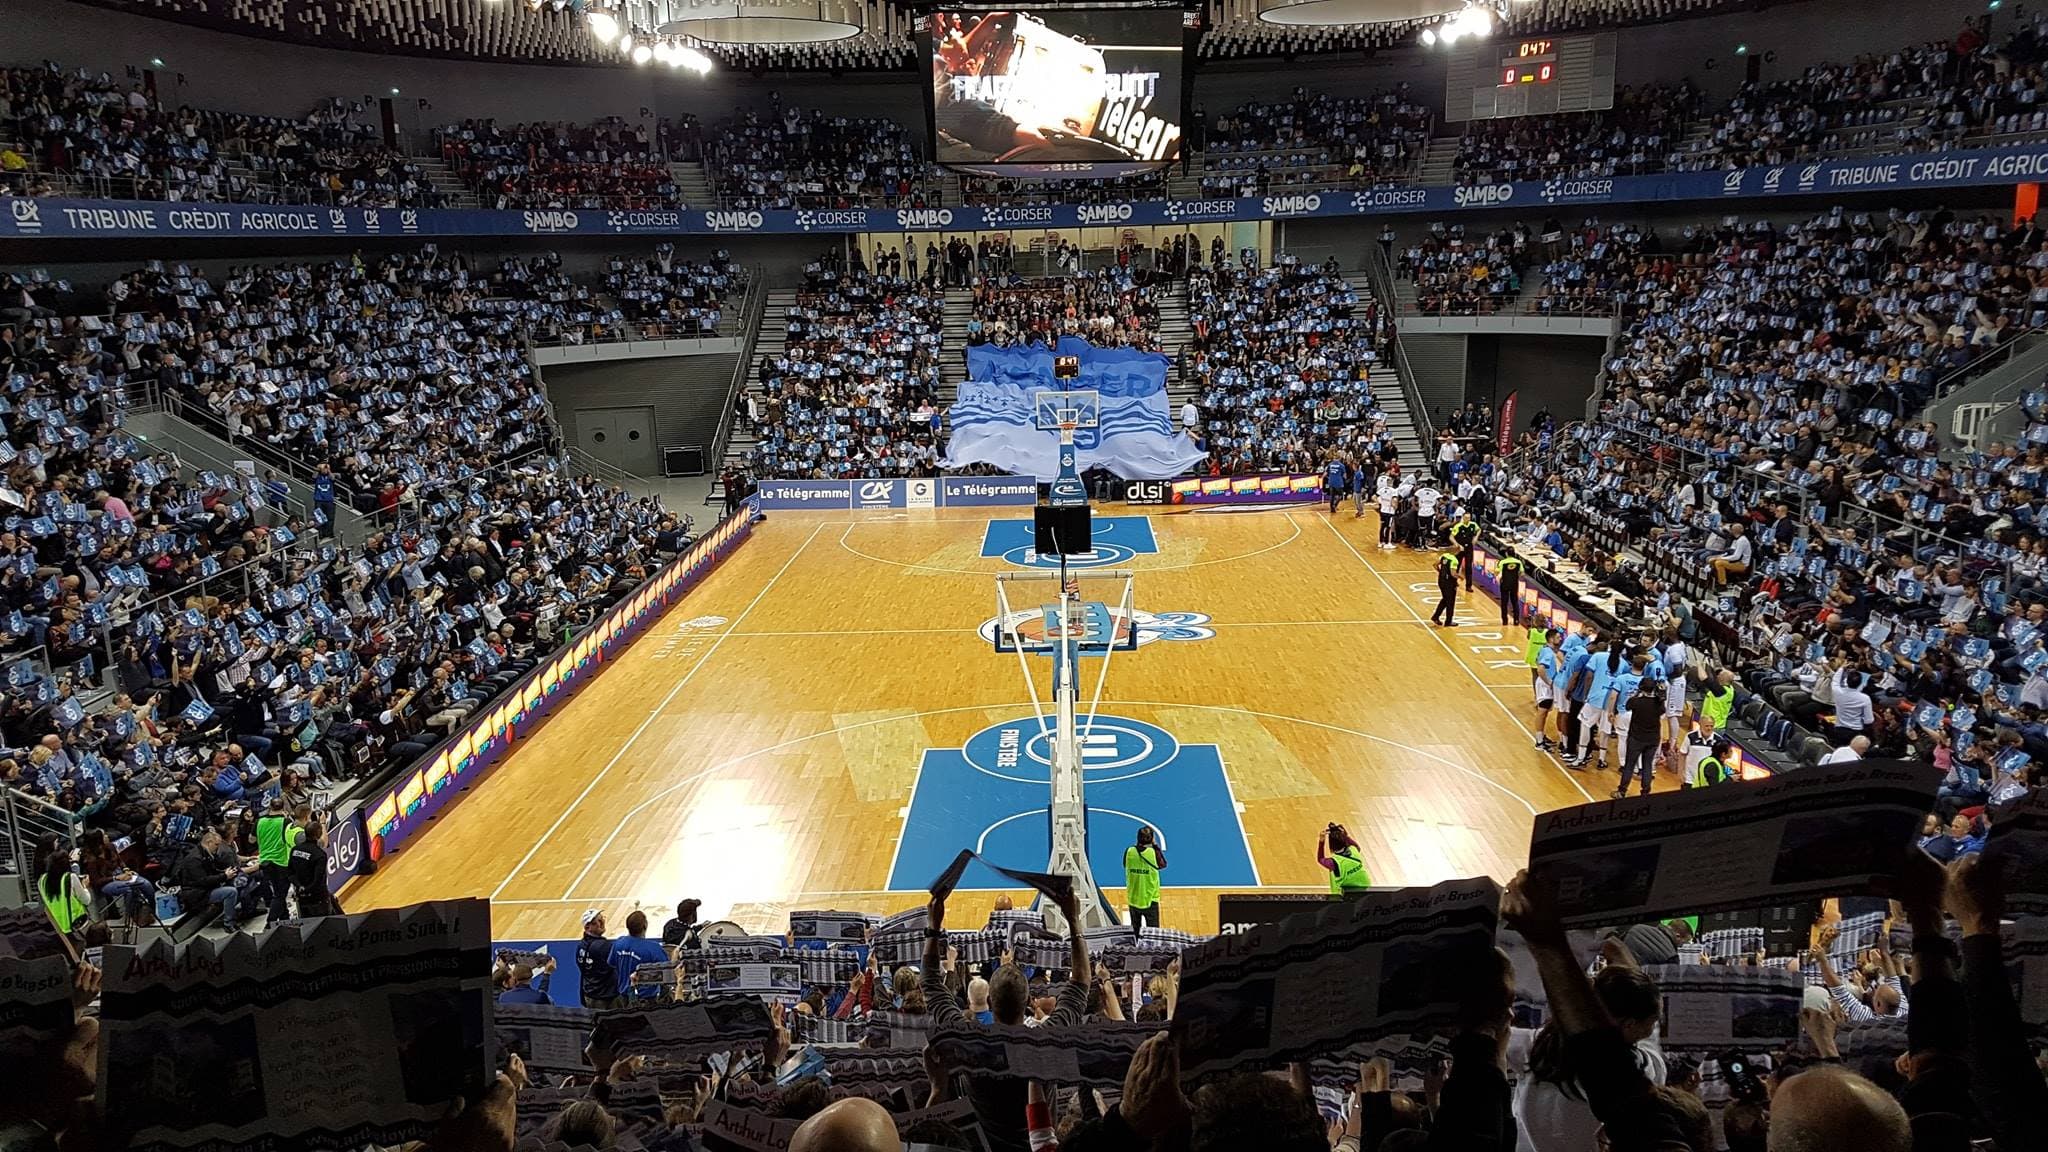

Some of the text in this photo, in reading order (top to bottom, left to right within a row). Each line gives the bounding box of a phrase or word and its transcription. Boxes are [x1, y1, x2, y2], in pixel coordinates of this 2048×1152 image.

[1505, 69, 1515, 83] 0
[1541, 65, 1551, 80] 0
[1829, 164, 1900, 187] TRIBUNE
[1910, 157, 1979, 181] CRÉDIT
[1454, 183, 1513, 207] SAMBO
[1563, 180, 1613, 196] CORSER
[1186, 200, 1235, 215] CORSER
[1263, 195, 1321, 216] SAMBO
[1374, 190, 1426, 206] CORSER
[63, 208, 319, 230] TRIBUNE CRÉDIT AGRICOLE
[524, 211, 578, 232] SAMBO
[629, 212, 680, 226] CORSER
[705, 211, 763, 232] SAMBO
[818, 212, 867, 225] CORSER
[897, 209, 953, 229] SAMBO
[1004, 208, 1052, 221] CORSER
[1077, 204, 1132, 224] SAMBO
[760, 487, 850, 501] Le Télégramme
[947, 483, 1036, 499] Le Télégramme
[1127, 481, 1163, 500] dlsi
[997, 729, 1022, 768] FINISTÈRE
[1546, 805, 1606, 833] Arthur
[1609, 800, 1651, 823] Loyd
[715, 1108, 790, 1149] Arthur Lo
